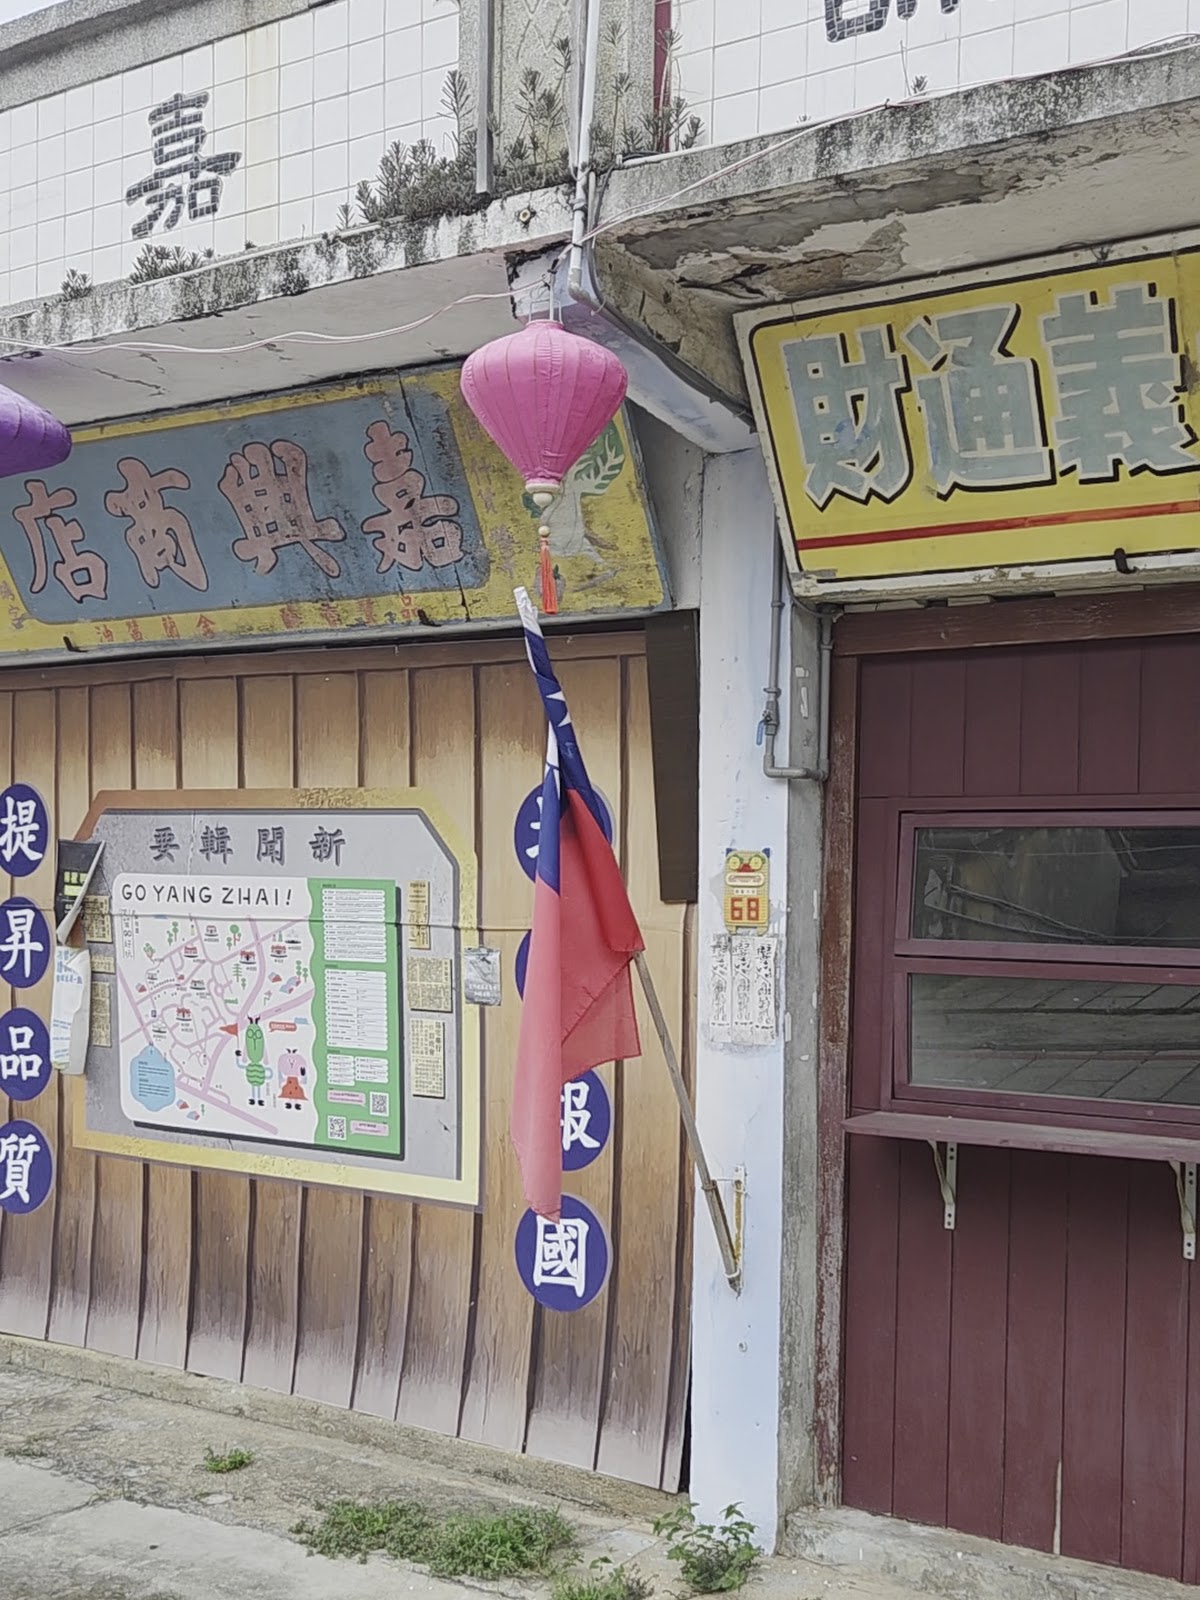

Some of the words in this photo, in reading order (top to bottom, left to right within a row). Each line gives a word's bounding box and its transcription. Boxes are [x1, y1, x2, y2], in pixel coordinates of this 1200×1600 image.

[126, 91, 242, 239] 嘉
[122, 884, 146, 901] GO
[153, 885, 212, 903] YANG
[222, 887, 292, 906] ZHAI!
[731, 897, 759, 921] 68
